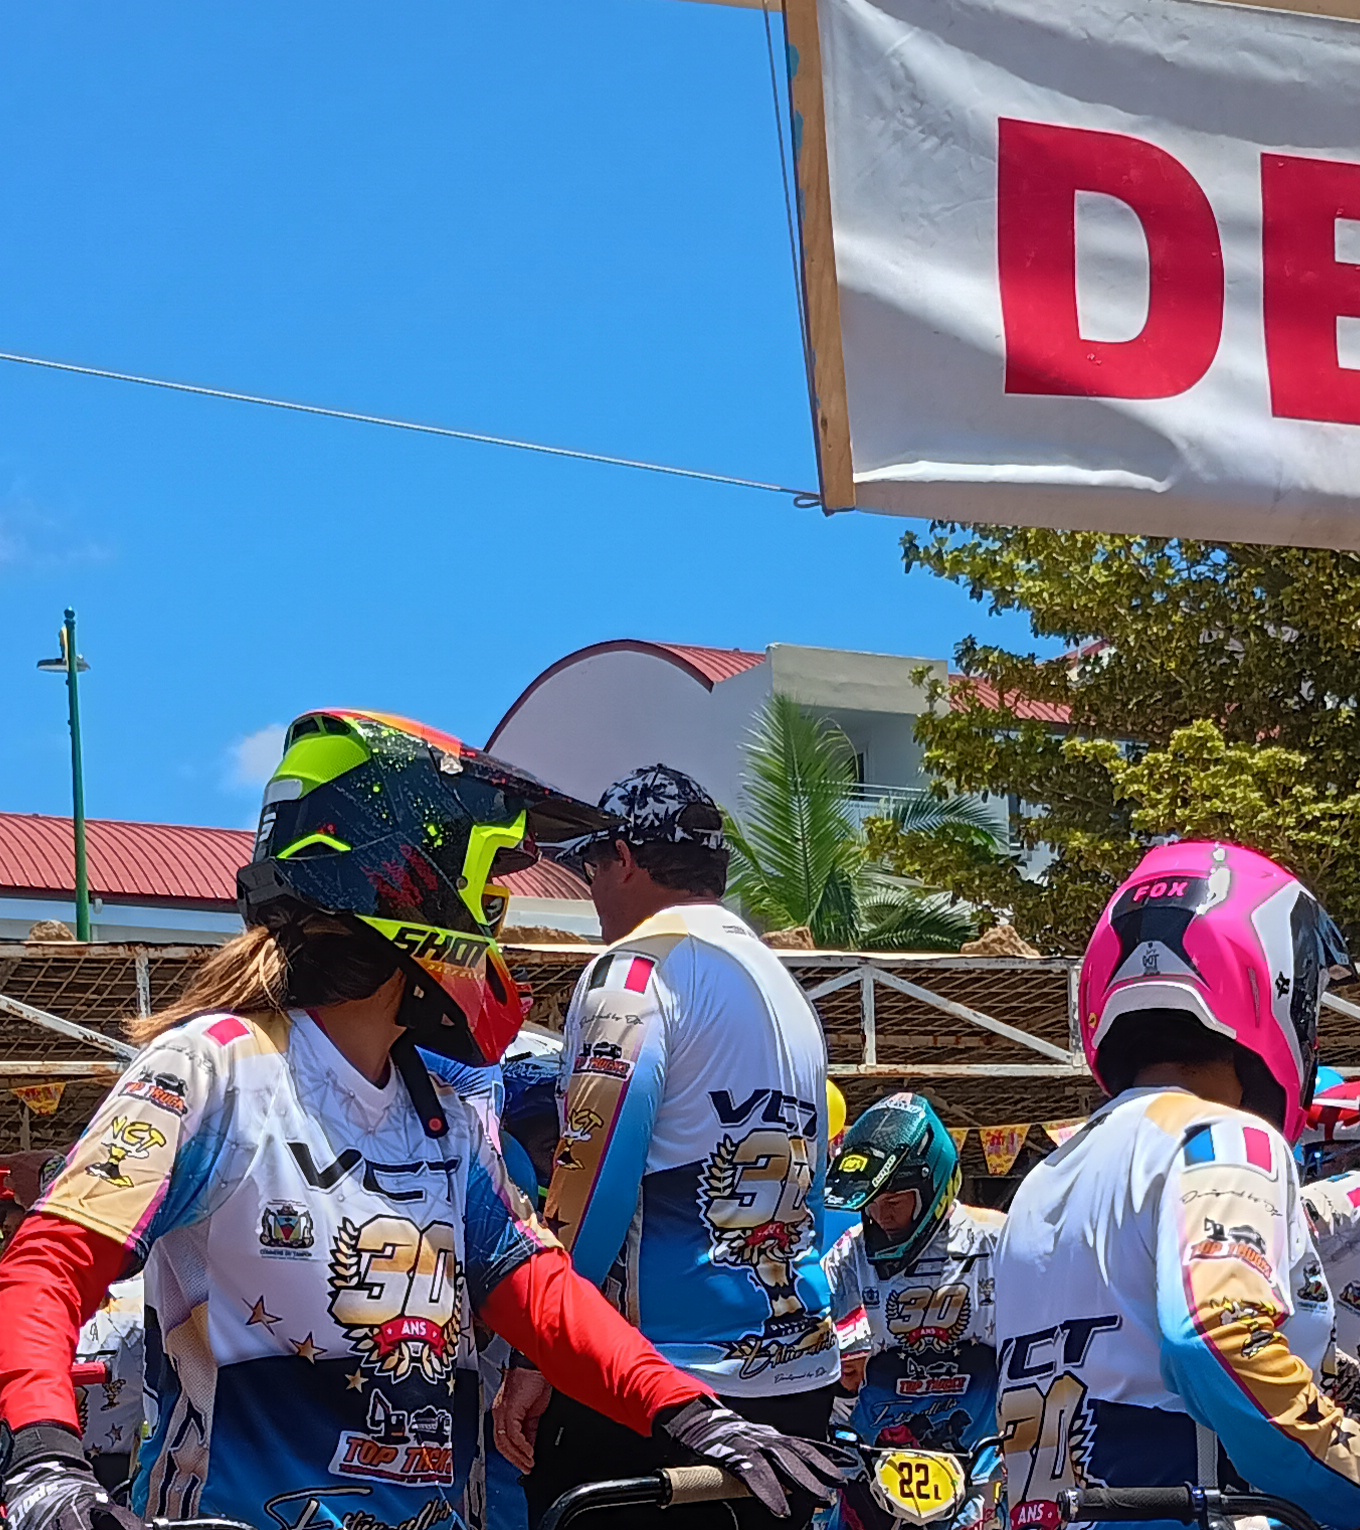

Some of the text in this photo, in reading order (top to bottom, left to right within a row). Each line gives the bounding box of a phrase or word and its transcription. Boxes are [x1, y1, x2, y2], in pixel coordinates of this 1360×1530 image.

[1131, 880, 1189, 902] FOX
[111, 1115, 167, 1152] VCT
[327, 1213, 456, 1328] 30
[888, 1281, 971, 1335] 30
[401, 1321, 428, 1337] ANS
[344, 1436, 396, 1467] TOP
[1016, 1503, 1044, 1525] ANS
